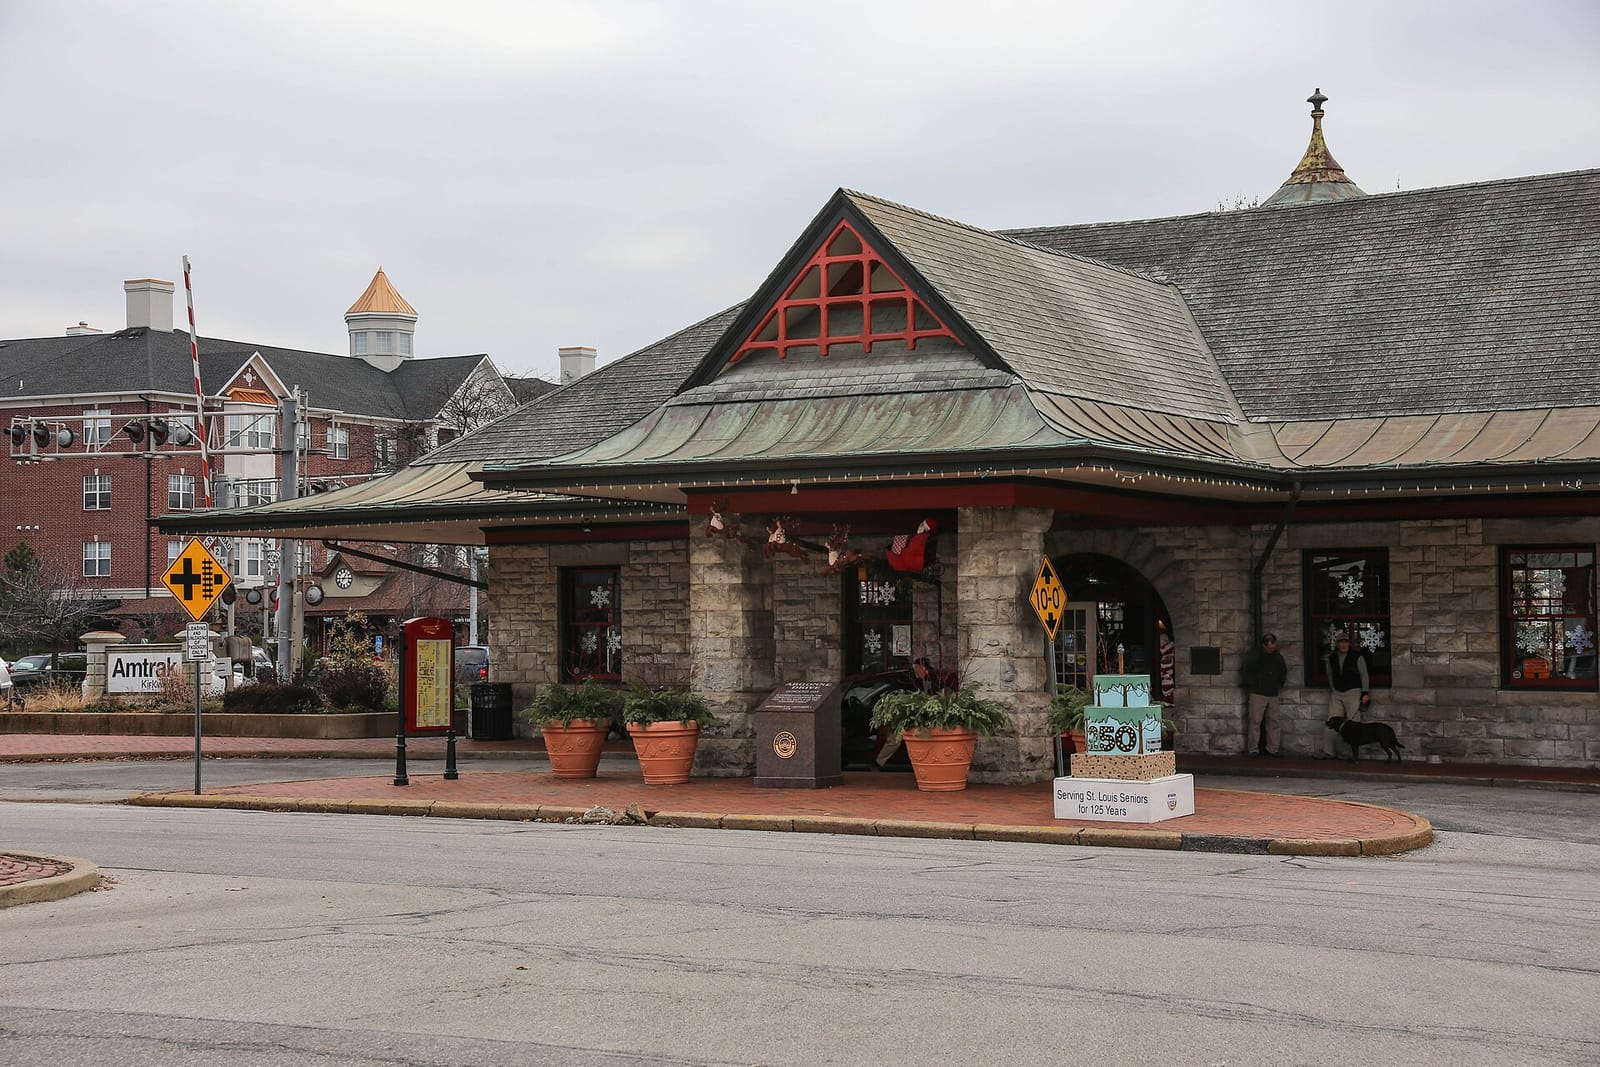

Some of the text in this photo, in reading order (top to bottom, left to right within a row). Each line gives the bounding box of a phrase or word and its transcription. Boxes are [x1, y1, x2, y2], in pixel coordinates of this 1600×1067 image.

[215, 547, 220, 555] 2
[112, 657, 177, 677] Amtrak
[1057, 790, 1149, 805] Serving St. Louis Seniors
[1078, 804, 1127, 816] for 125 Years
